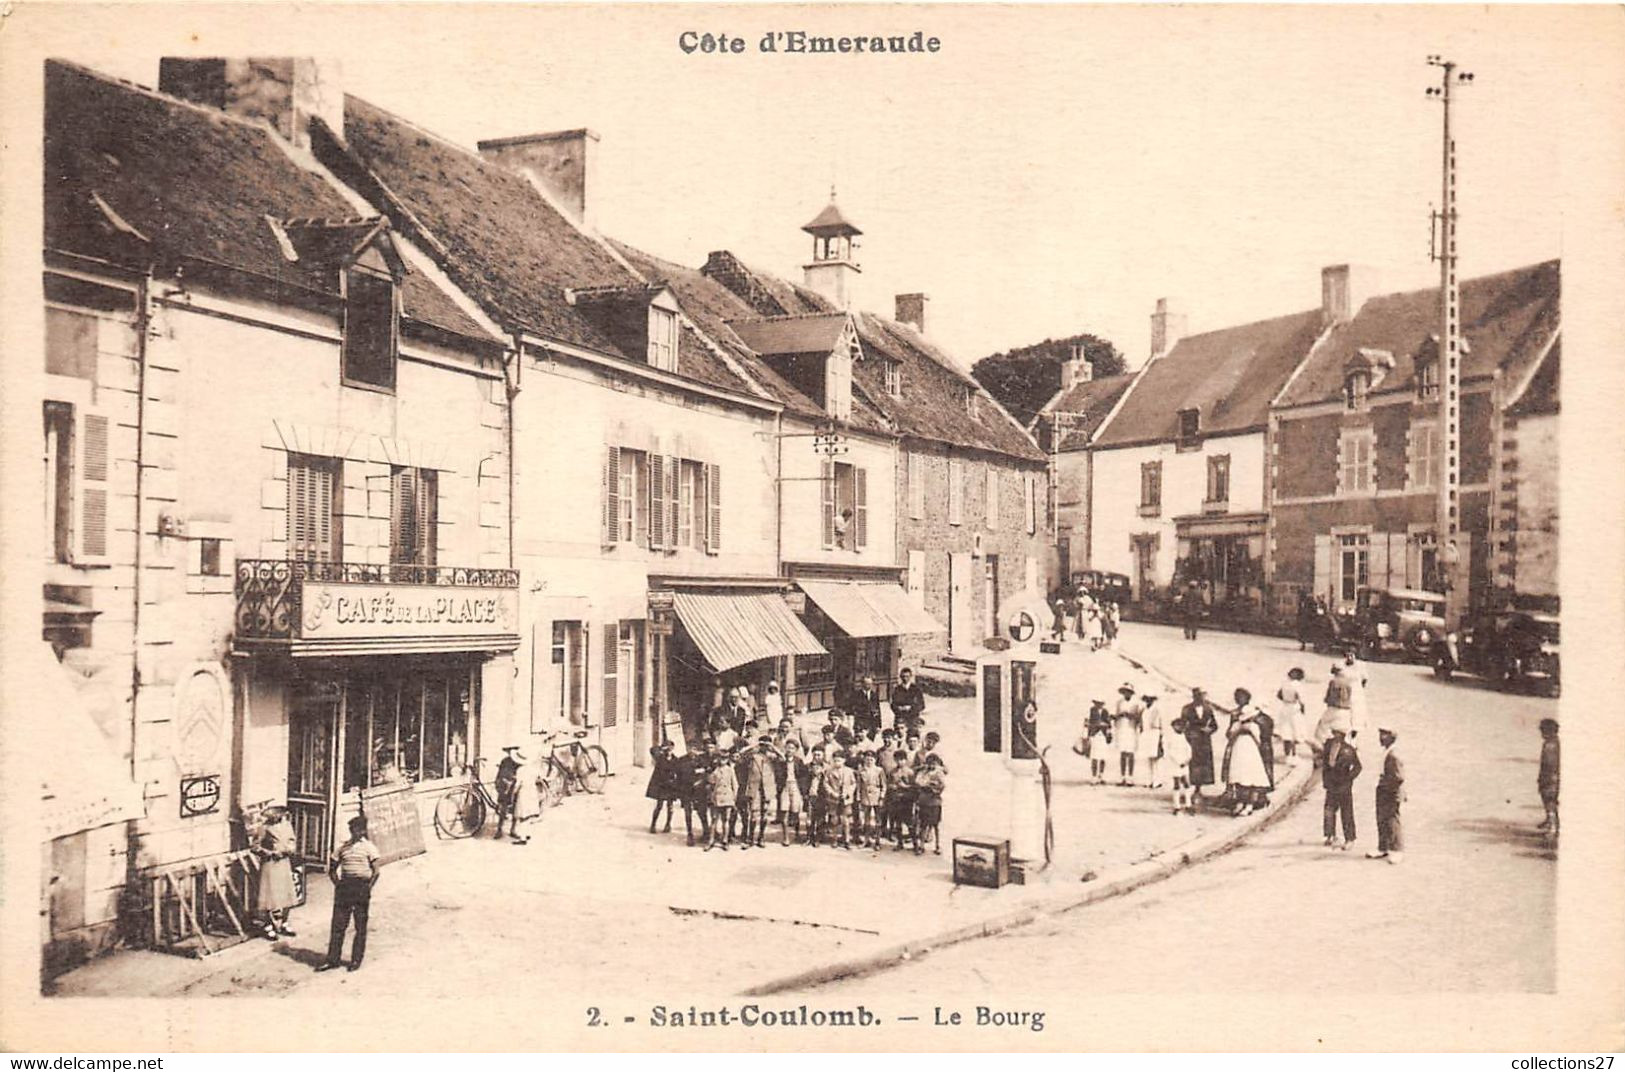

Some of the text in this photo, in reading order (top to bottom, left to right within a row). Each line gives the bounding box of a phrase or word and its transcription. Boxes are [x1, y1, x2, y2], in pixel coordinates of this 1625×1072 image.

[336, 592, 396, 624] CAFÉ
[415, 606, 433, 624] LA
[434, 598, 497, 624] PLACE
